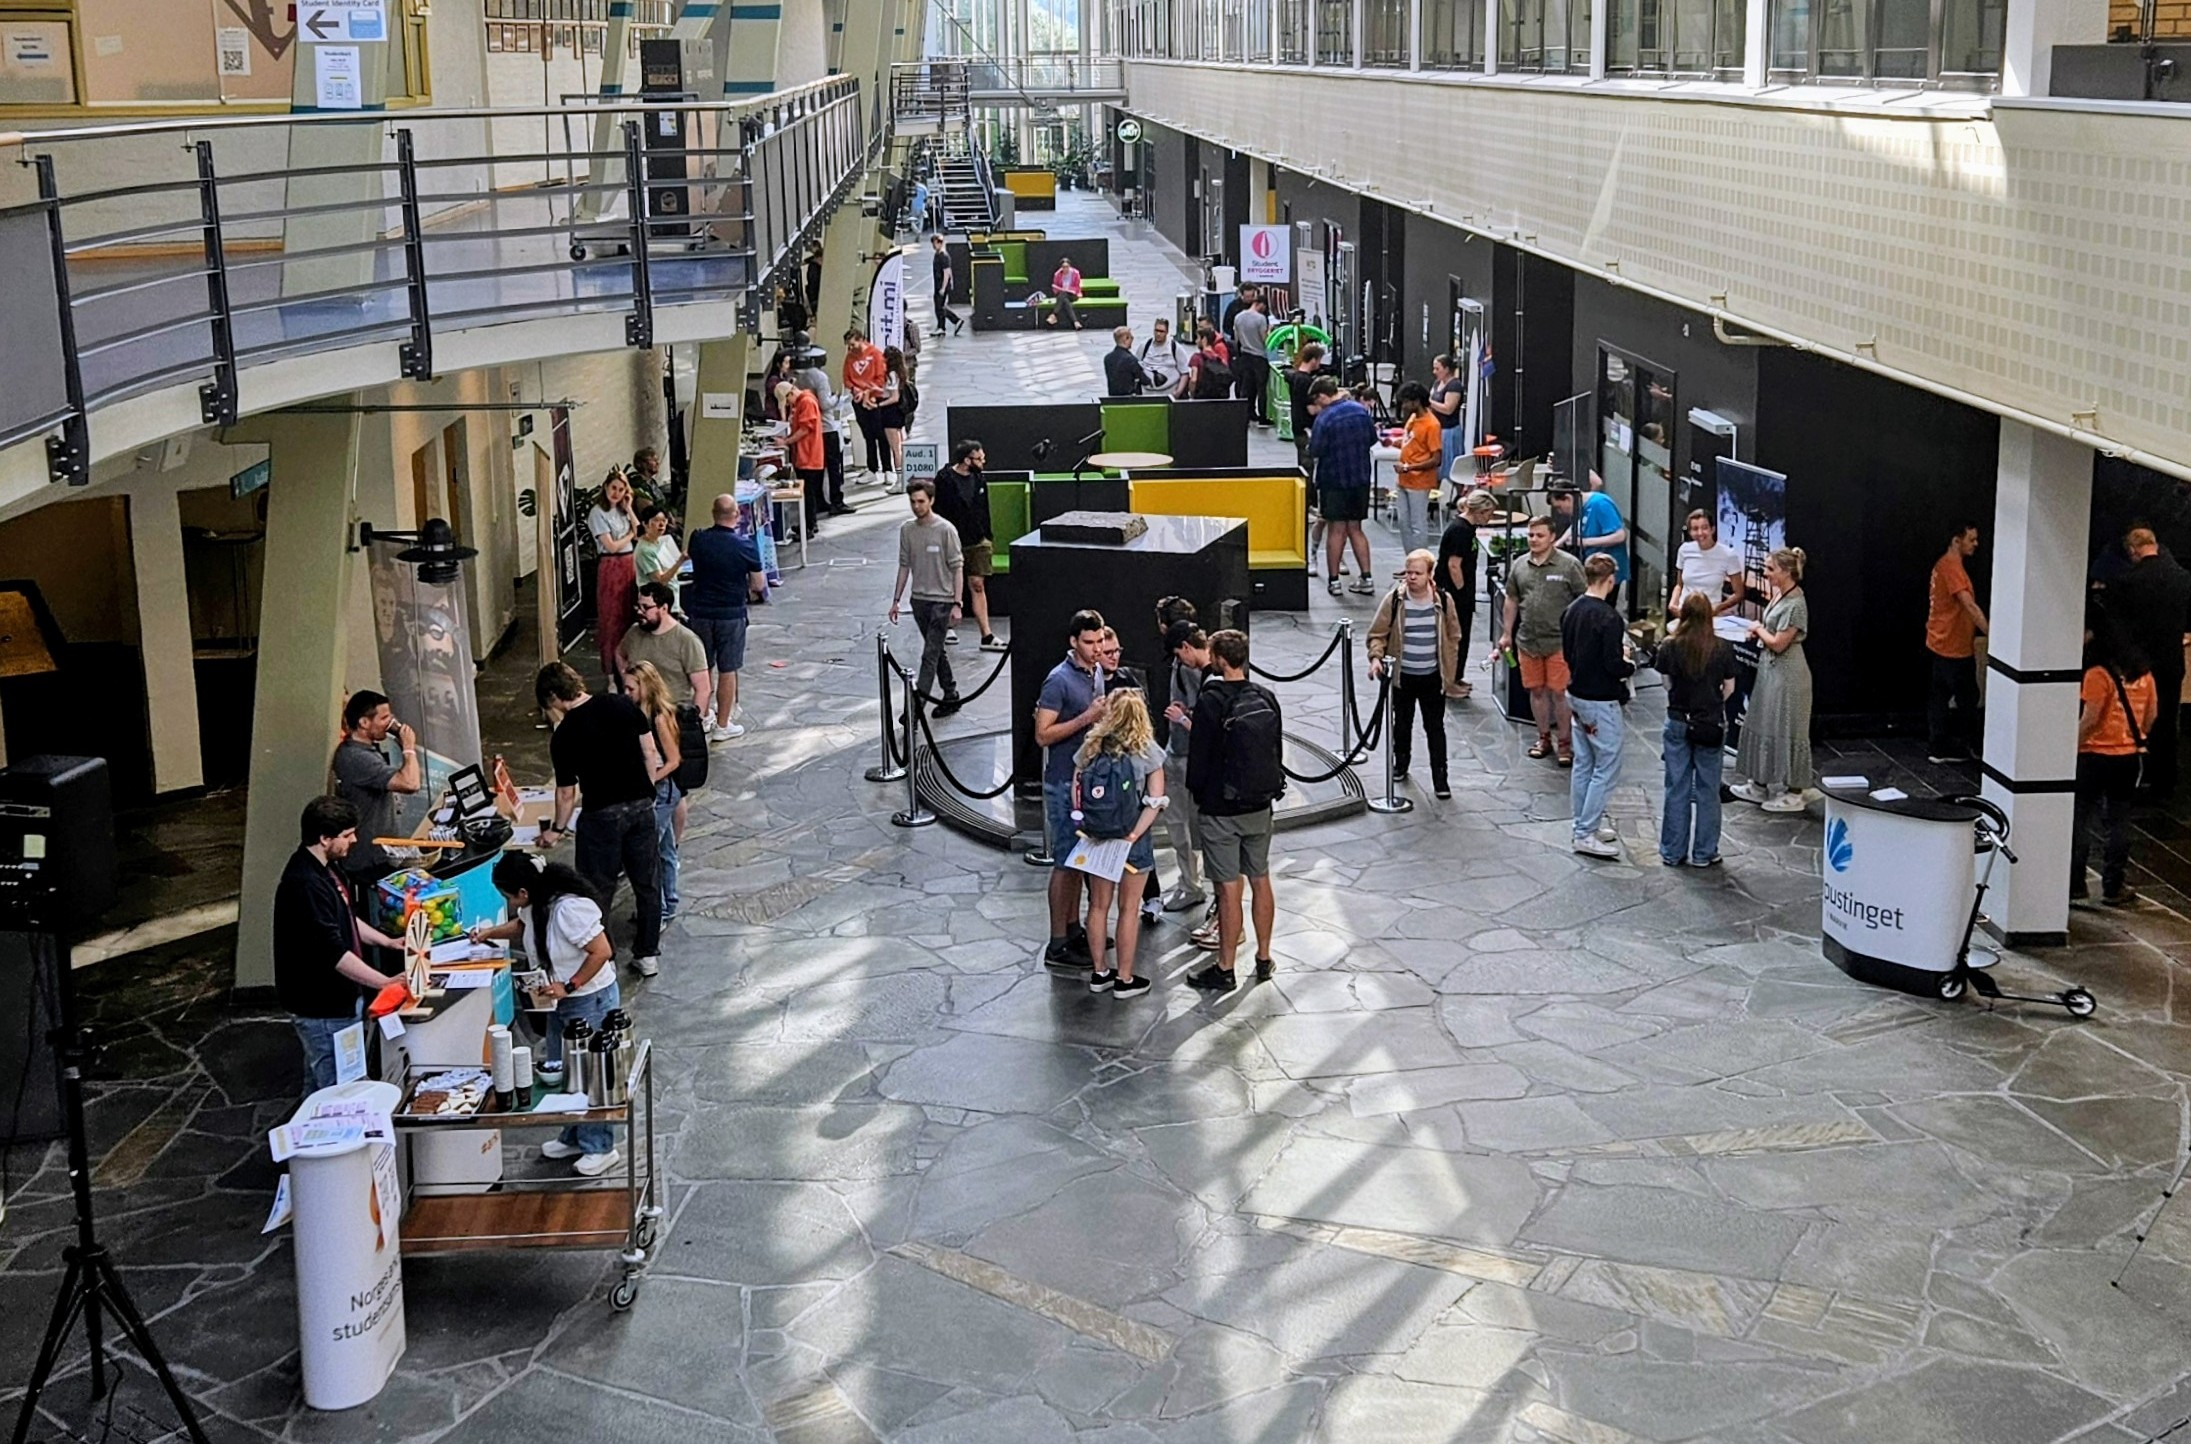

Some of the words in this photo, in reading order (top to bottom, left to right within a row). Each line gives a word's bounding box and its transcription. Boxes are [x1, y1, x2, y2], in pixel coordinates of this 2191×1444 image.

[332, 0, 360, 8] Identity
[905, 449, 927, 459] Aud.
[928, 449, 934, 458] 1
[906, 463, 934, 473] D1080
